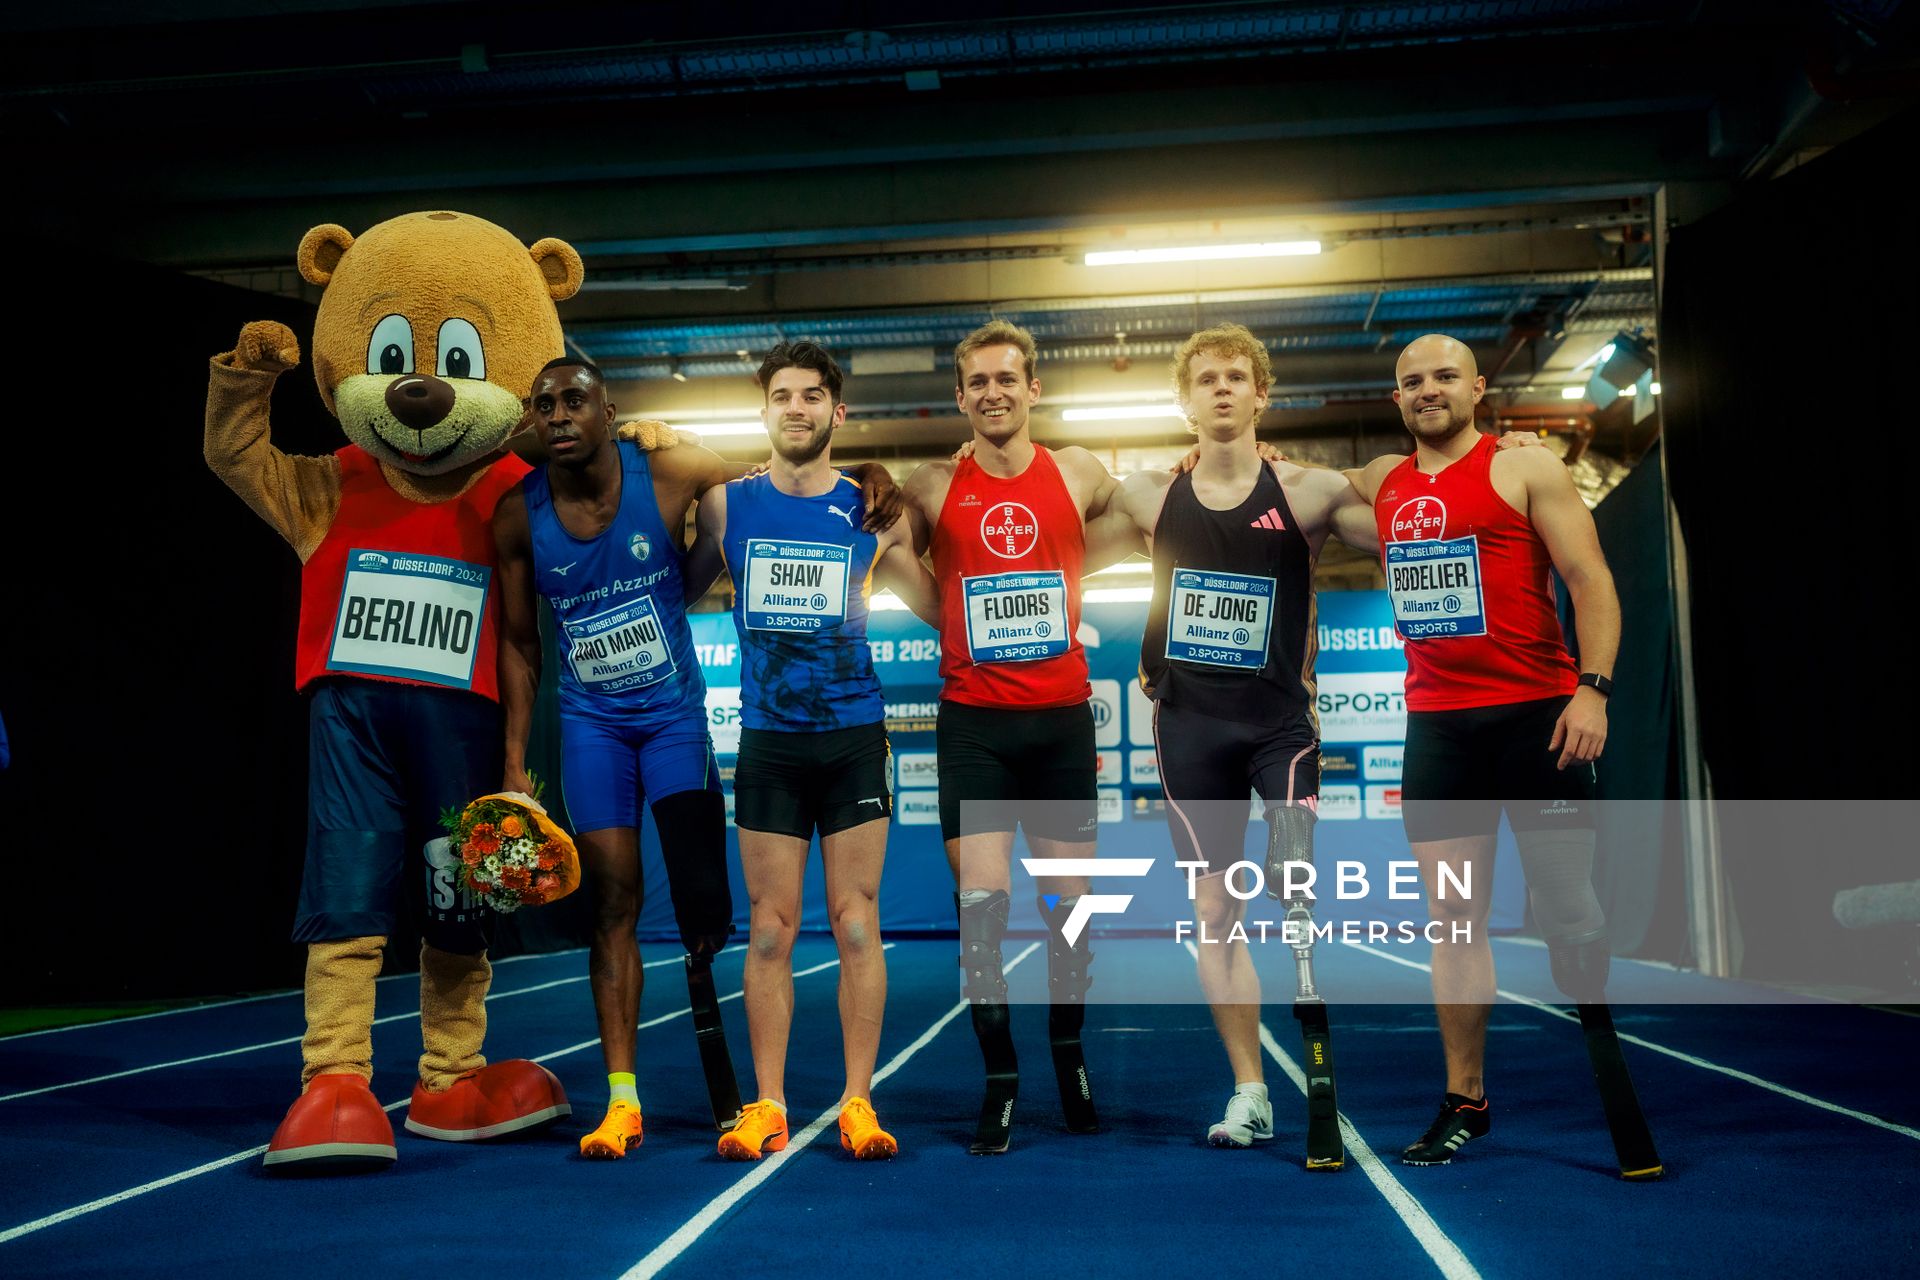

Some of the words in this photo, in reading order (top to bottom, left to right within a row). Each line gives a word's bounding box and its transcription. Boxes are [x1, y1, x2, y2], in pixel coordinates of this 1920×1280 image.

[1395, 517, 1442, 531] BAYER
[1413, 501, 1427, 540] BAYE
[985, 525, 1034, 536] BAYER
[780, 545, 826, 558] DÜSSELDORF
[826, 551, 845, 560] 2024
[1449, 545, 1471, 554] 2024
[392, 557, 455, 577] DÜSSELDORF
[455, 567, 484, 583] 2024
[770, 562, 824, 588] SHAW
[1393, 562, 1469, 592] BODELIER
[612, 566, 670, 595] Azzurre
[996, 577, 1040, 589] DÜSSELDORF
[1040, 577, 1059, 586] 2024
[1204, 577, 1249, 591] DÜSSELDORF
[1249, 582, 1269, 593] 2024
[763, 593, 808, 607] Allianz
[983, 592, 1051, 621] FLOORS
[1402, 600, 1441, 613] Allianz
[1184, 593, 1206, 617] DE
[1209, 596, 1258, 624] JONG
[342, 595, 474, 655] BERLINO
[586, 610, 630, 634] DÜSSELDORF
[630, 604, 648, 618] 2024
[766, 616, 822, 628] D.SPORTS
[988, 625, 1033, 640] Allianz
[1186, 624, 1230, 641] Allianz
[1407, 621, 1458, 635] D.SPORTS
[574, 637, 608, 662] AMO
[607, 619, 658, 656] MANU
[994, 645, 1049, 659] D.SPORTS
[1188, 647, 1242, 662] D.SPORTS
[592, 657, 635, 676] Allianz
[601, 671, 654, 691] D.SPORTS
